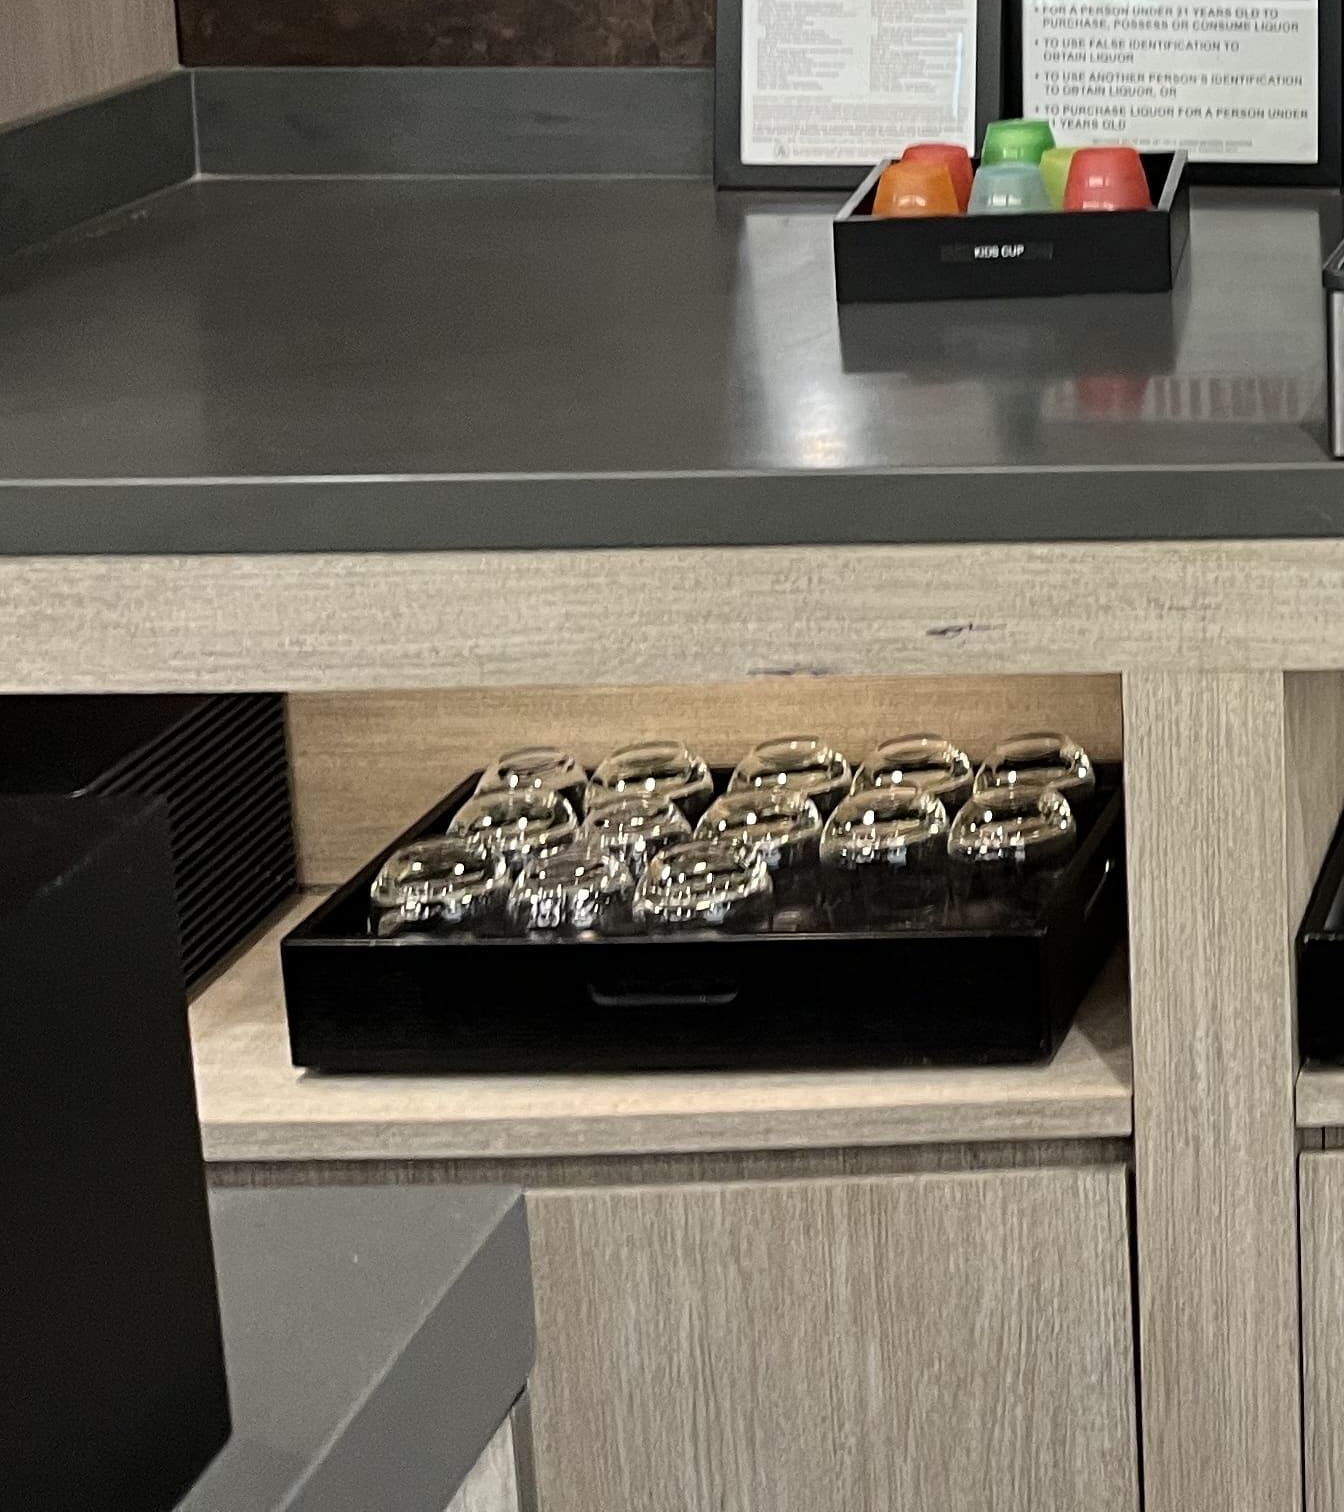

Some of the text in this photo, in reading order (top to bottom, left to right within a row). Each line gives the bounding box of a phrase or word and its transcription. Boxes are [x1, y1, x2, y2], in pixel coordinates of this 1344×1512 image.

[1043, 7, 1065, 16] FOR
[1070, 7, 1077, 15] A
[1081, 7, 1129, 17] PERSON
[1133, 8, 1173, 18] UNDER
[1193, 8, 1232, 18] YEARS
[1235, 9, 1259, 18] OLD
[1264, 10, 1278, 18] TO
[1114, 20, 1168, 30] POSSESS
[1172, 21, 1188, 31] OR
[1193, 21, 1250, 32] CONSUME
[1255, 22, 1299, 33] LIQUOR
[1044, 39, 1239, 52] TO USE FALSE IDENTIFICATION TO
[1043, 52, 1134, 63] OBTAIN LIQUOR
[1045, 72, 1059, 82] TO
[1063, 72, 1085, 82] USE
[1089, 73, 1145, 83] ANOTHER
[1211, 74, 1302, 86] IDENTIFICATION
[1045, 85, 1059, 95] TO
[1063, 86, 1105, 96] OBTAIN
[1160, 87, 1177, 97] OR
[1045, 105, 1308, 119] TO PURCHASE LIQUOR FOR A PERSON UNDER
[1060, 120, 1098, 130] YEARS
[1102, 120, 1126, 130] OLD
[1001, 243, 1025, 258] CUP
